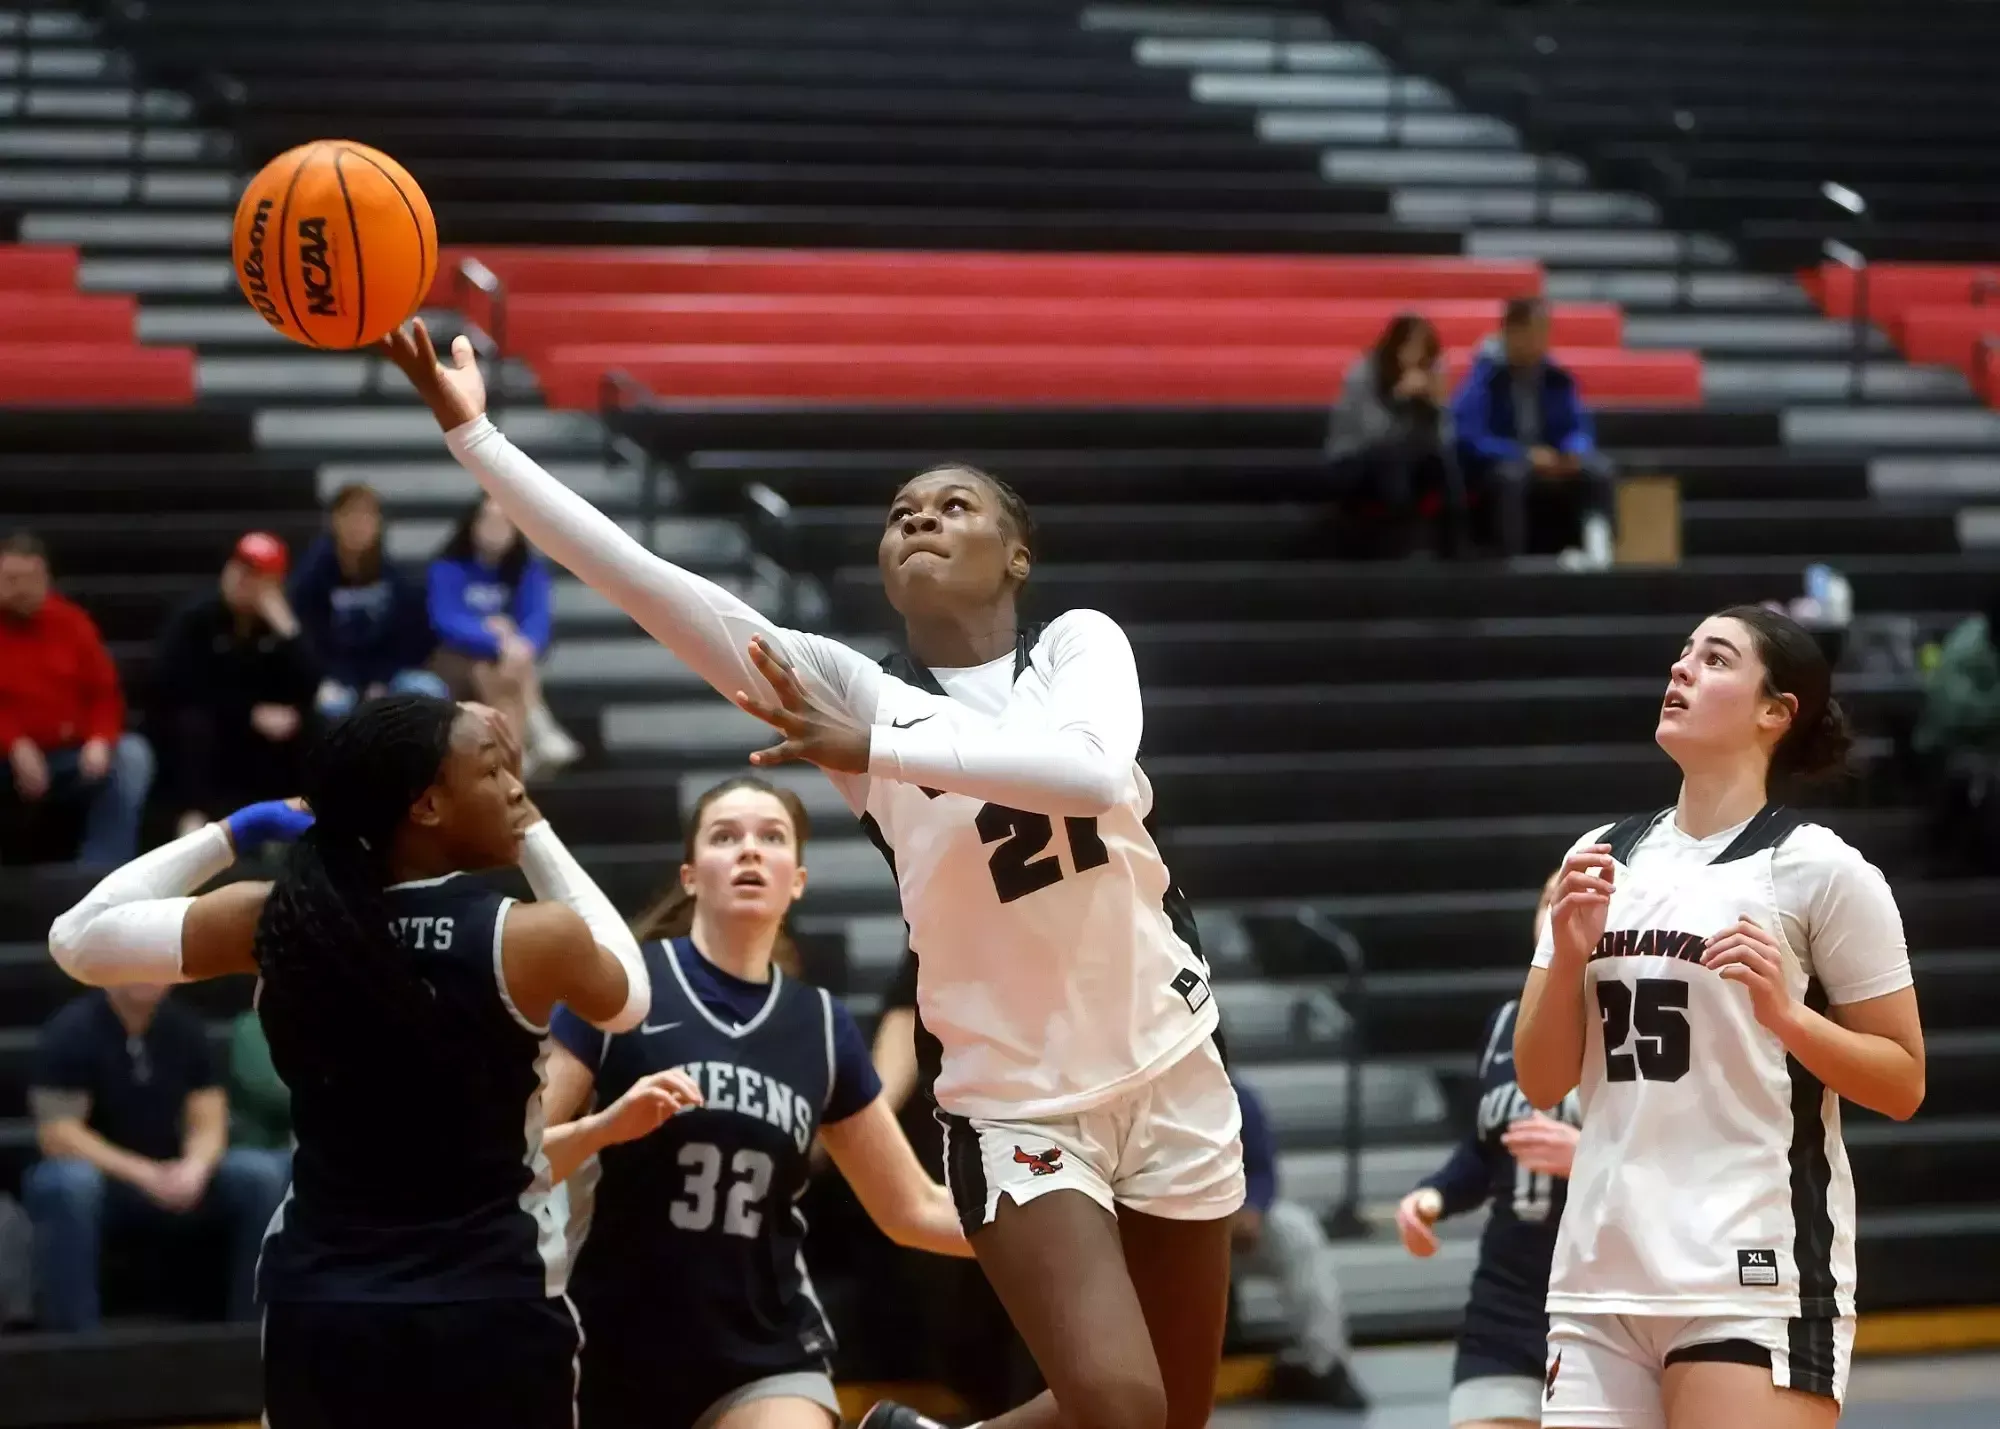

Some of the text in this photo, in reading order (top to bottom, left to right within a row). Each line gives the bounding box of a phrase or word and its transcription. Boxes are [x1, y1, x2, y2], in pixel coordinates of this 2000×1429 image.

[244, 199, 284, 325] Wilson
[299, 217, 337, 316] NCAA
[975, 801, 1109, 904] 21
[1597, 979, 1690, 1083] 25
[669, 1142, 774, 1239] 32
[1748, 1252, 1769, 1264] XL
